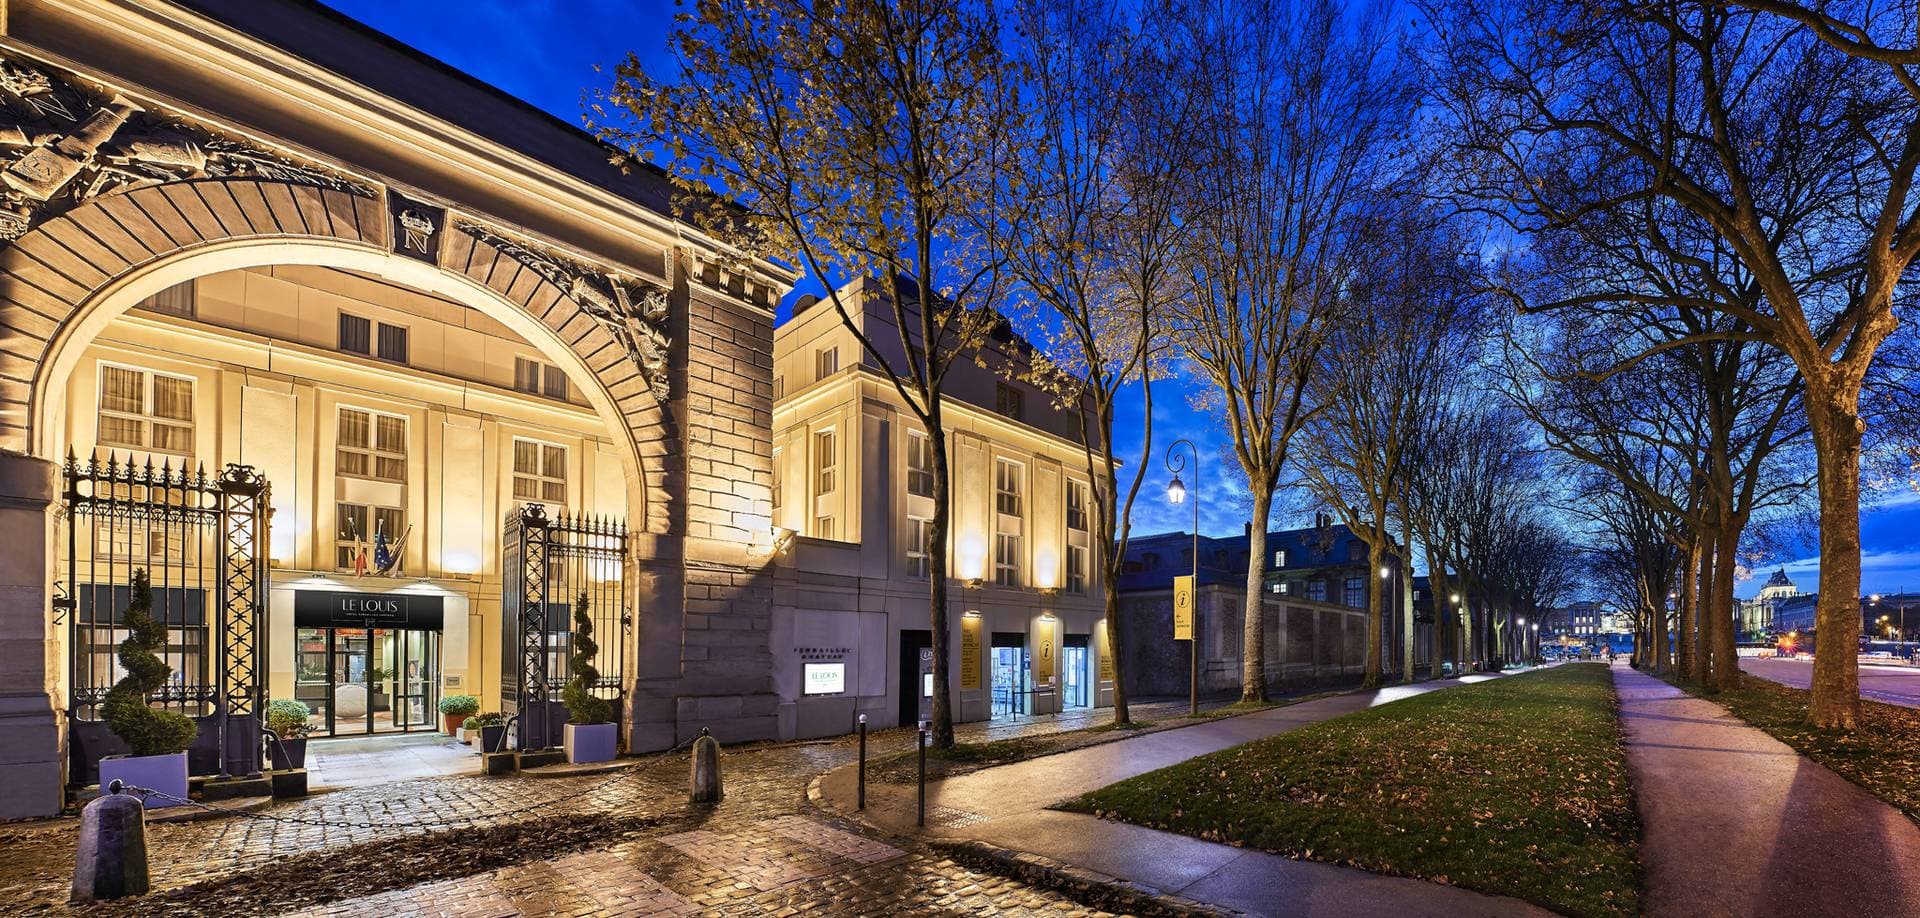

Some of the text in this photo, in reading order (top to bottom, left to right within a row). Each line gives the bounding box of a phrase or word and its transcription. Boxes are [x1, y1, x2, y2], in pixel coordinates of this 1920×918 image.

[404, 228, 429, 254] N
[342, 599, 398, 613] LE LOUIS
